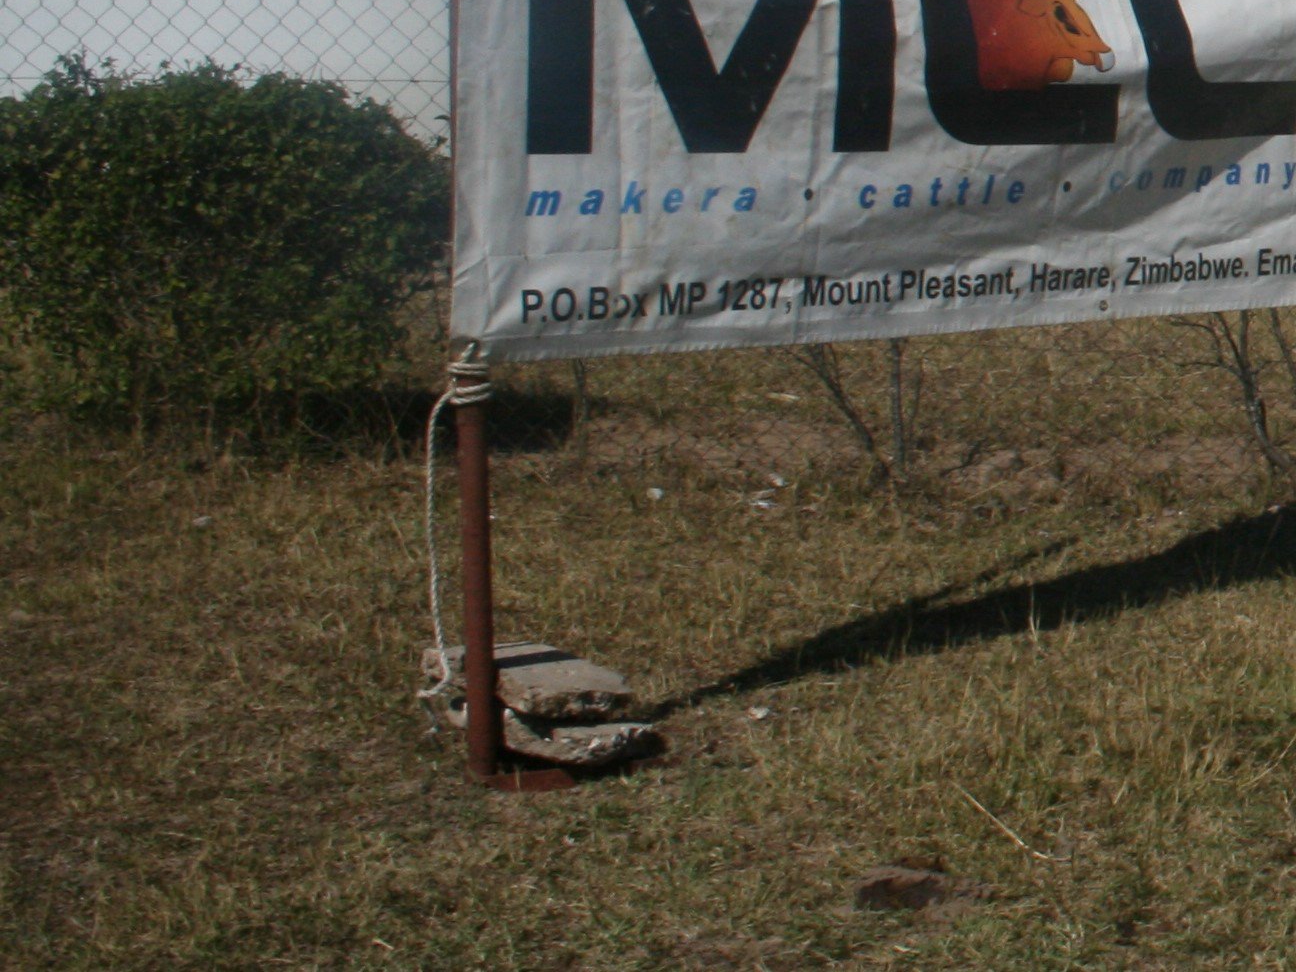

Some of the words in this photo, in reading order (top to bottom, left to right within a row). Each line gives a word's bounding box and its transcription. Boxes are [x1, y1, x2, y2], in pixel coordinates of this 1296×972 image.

[525, 181, 757, 217] makera
[859, 175, 1025, 209] cattle
[659, 282, 706, 316] MP
[718, 278, 792, 315] 1287,
[803, 274, 891, 308] Mount
[900, 266, 1020, 302] Pleasant,
[1030, 260, 1117, 293] Harare,
[1124, 249, 1250, 288] Zimbabwe.
